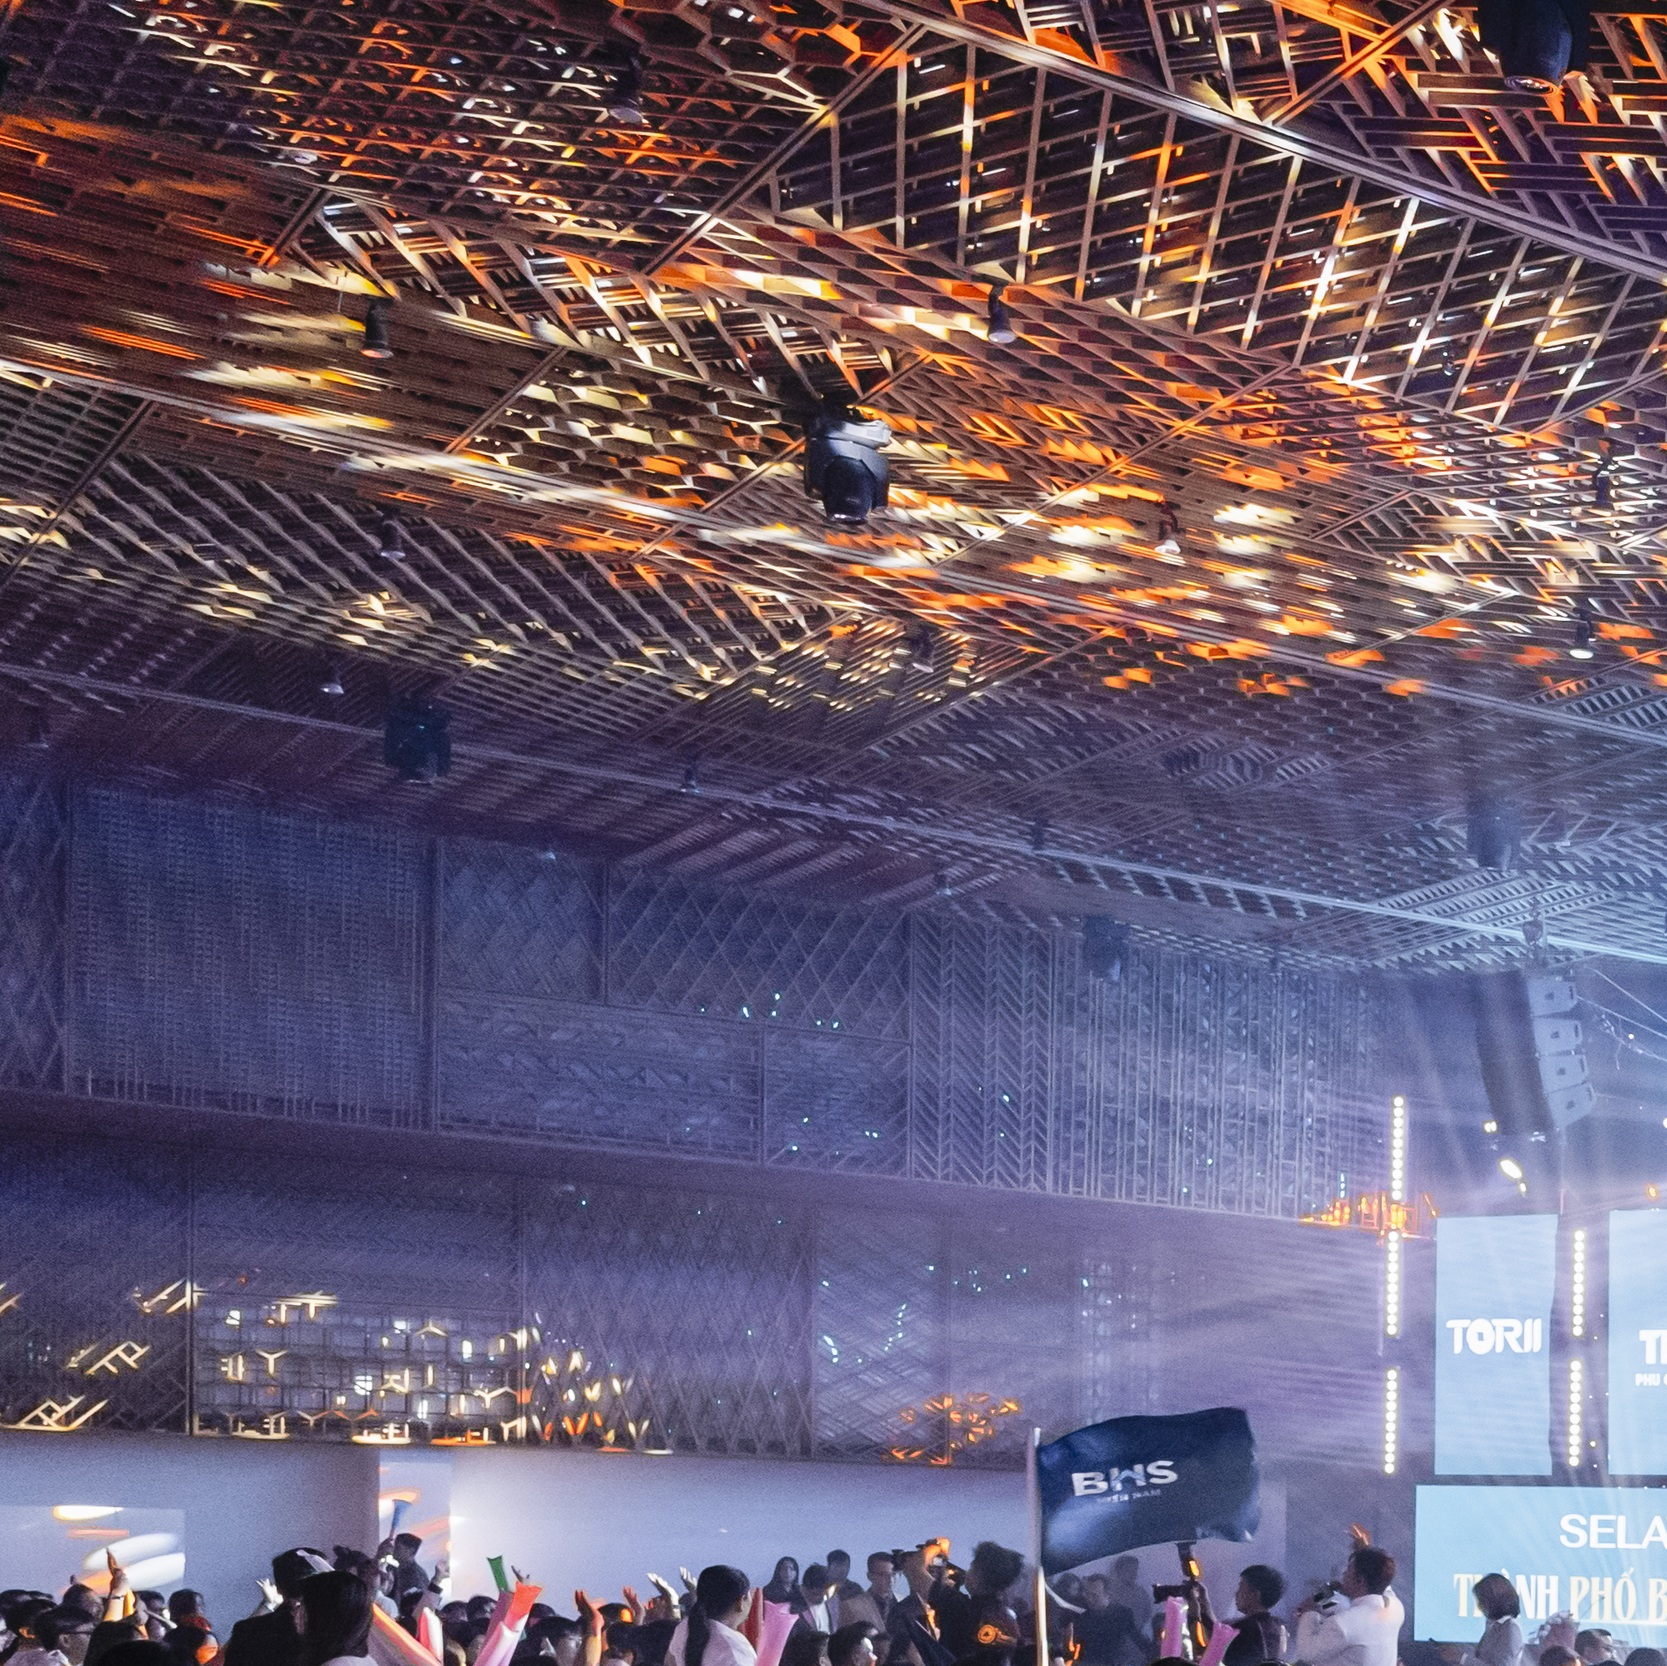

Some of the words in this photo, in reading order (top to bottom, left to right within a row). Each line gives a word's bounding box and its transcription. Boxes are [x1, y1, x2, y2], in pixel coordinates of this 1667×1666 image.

[1445, 1317, 1542, 1356] TORII
[1634, 1373, 1660, 1387] PHU
[1071, 1460, 1179, 1497] BHS
[1453, 1568, 1559, 1620] TNH
[1569, 1566, 1635, 1622] PHỐ
